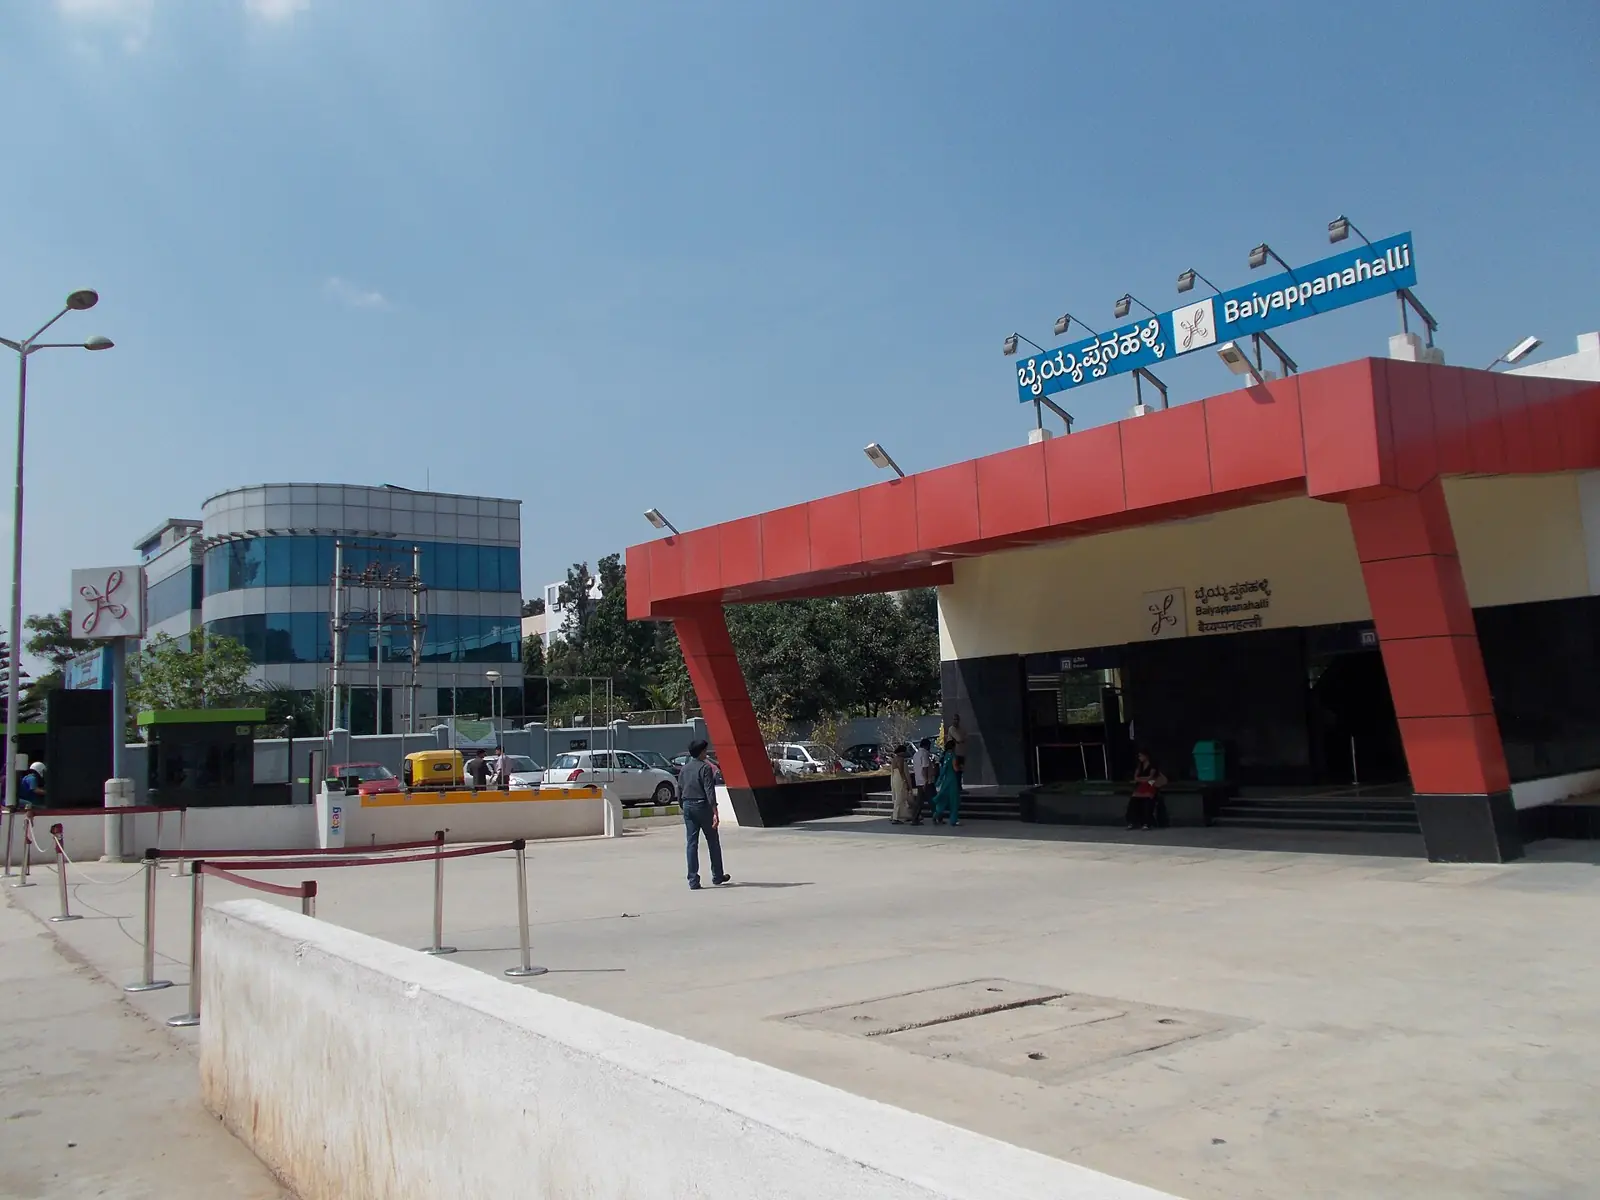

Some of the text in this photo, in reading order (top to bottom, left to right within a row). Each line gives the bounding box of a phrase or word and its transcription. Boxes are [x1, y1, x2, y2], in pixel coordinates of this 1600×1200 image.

[1224, 243, 1410, 324] Baiyappanahalli
[1018, 319, 1164, 395] ಬೈಯ್ಯಪ್ಪನಹಳ್ಳಿ
[1196, 598, 1269, 616] Baiyappanahalli
